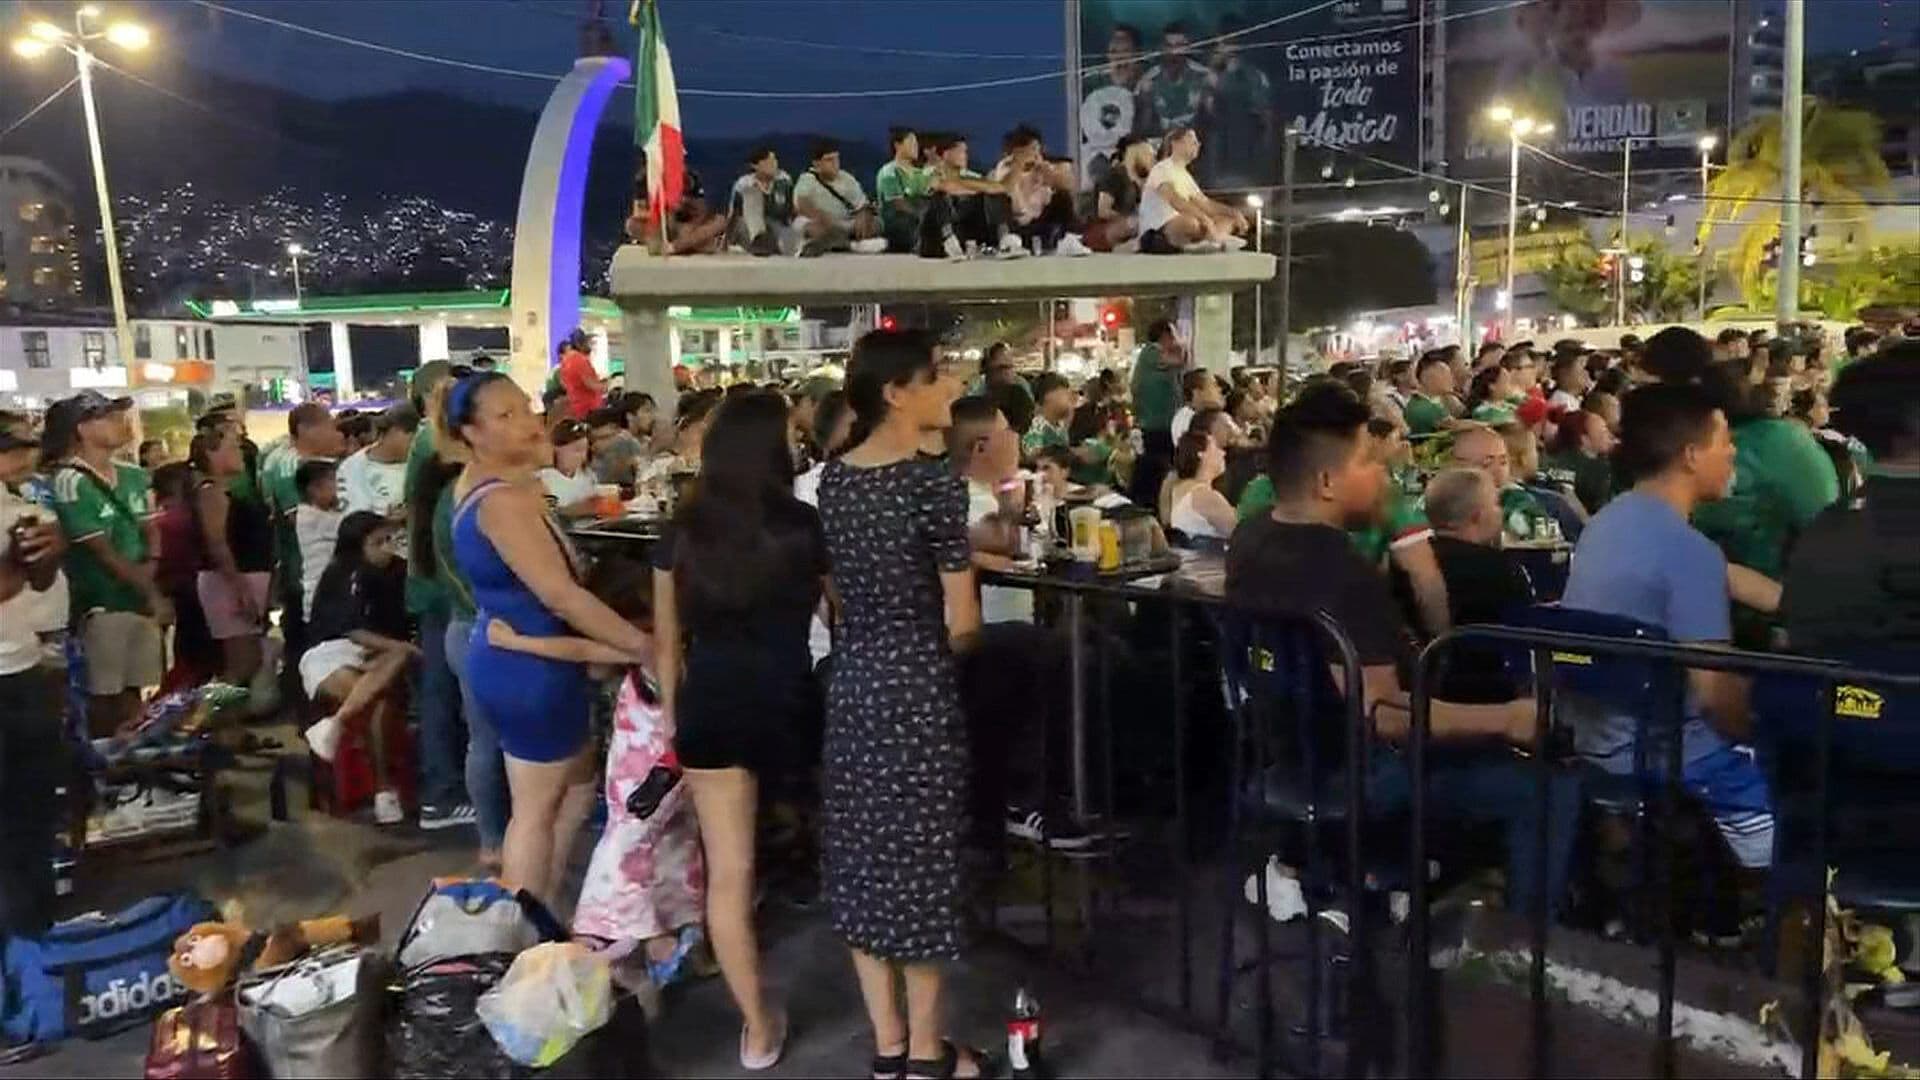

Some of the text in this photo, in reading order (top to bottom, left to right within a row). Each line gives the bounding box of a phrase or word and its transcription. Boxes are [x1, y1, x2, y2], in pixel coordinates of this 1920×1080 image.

[1286, 41, 1401, 60] Conectamos
[1289, 58, 1398, 84] la pasión de
[1320, 78, 1373, 108] todo
[1294, 111, 1398, 147] México
[1567, 104, 1651, 138] VERDAD
